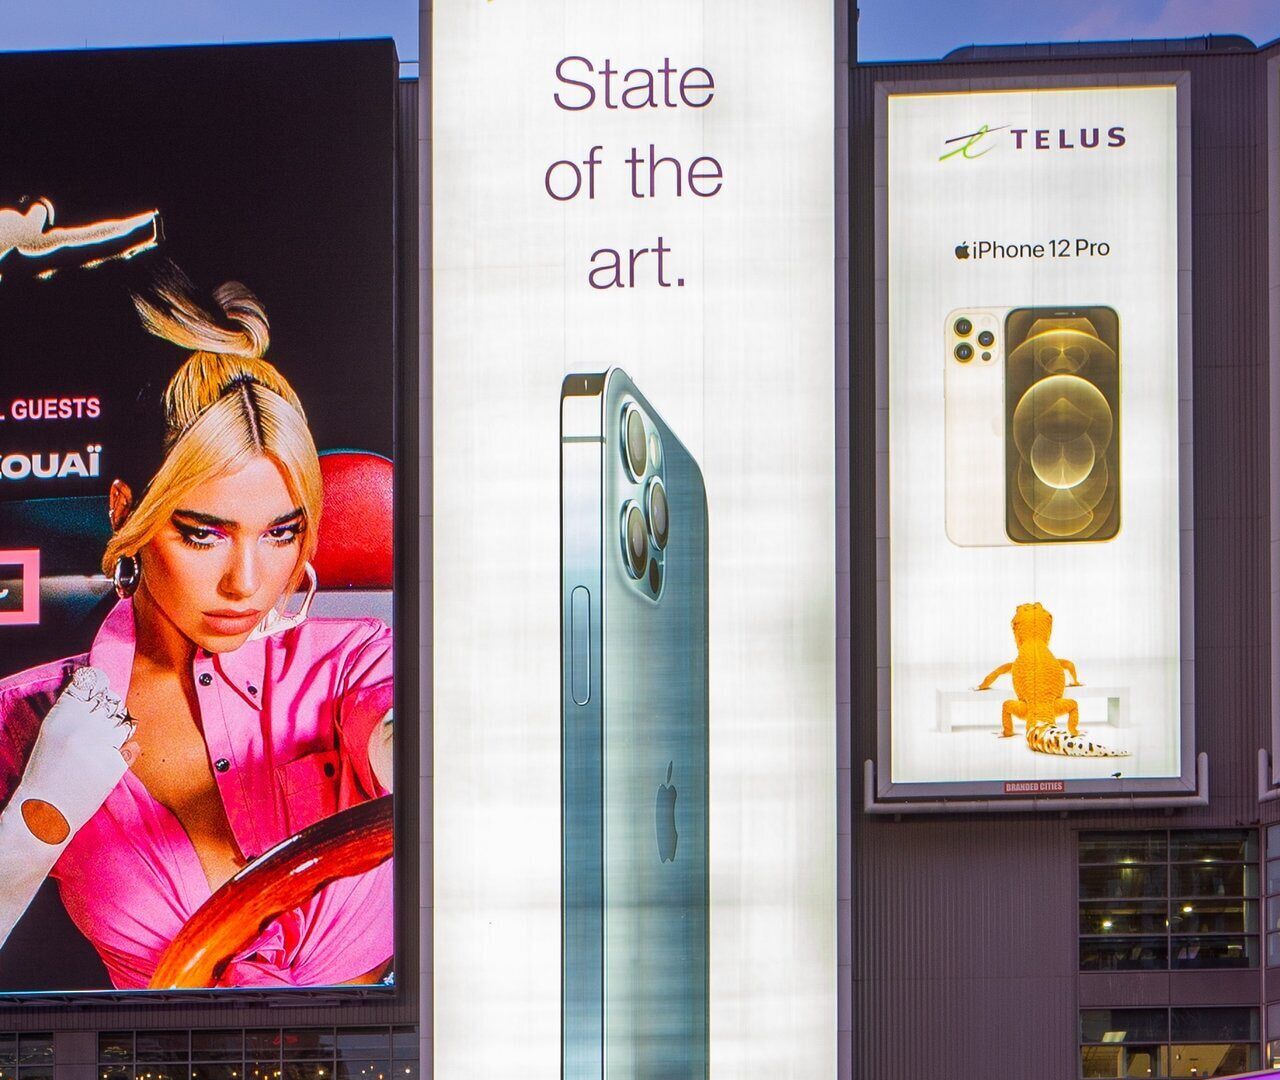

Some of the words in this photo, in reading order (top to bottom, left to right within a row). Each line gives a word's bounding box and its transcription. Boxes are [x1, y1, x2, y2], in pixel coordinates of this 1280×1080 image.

[552, 54, 716, 111] State
[1009, 126, 1127, 150] TELUS
[545, 145, 604, 200] of
[629, 144, 724, 198] the
[973, 240, 1045, 260] iPhone
[1049, 239, 1071, 258] 12
[1075, 238, 1111, 257] Pro
[587, 235, 686, 291] art.
[10, 397, 102, 422] GUESTS
[1005, 782, 1040, 792] BRANDED
[1039, 781, 1064, 791] CITIES
